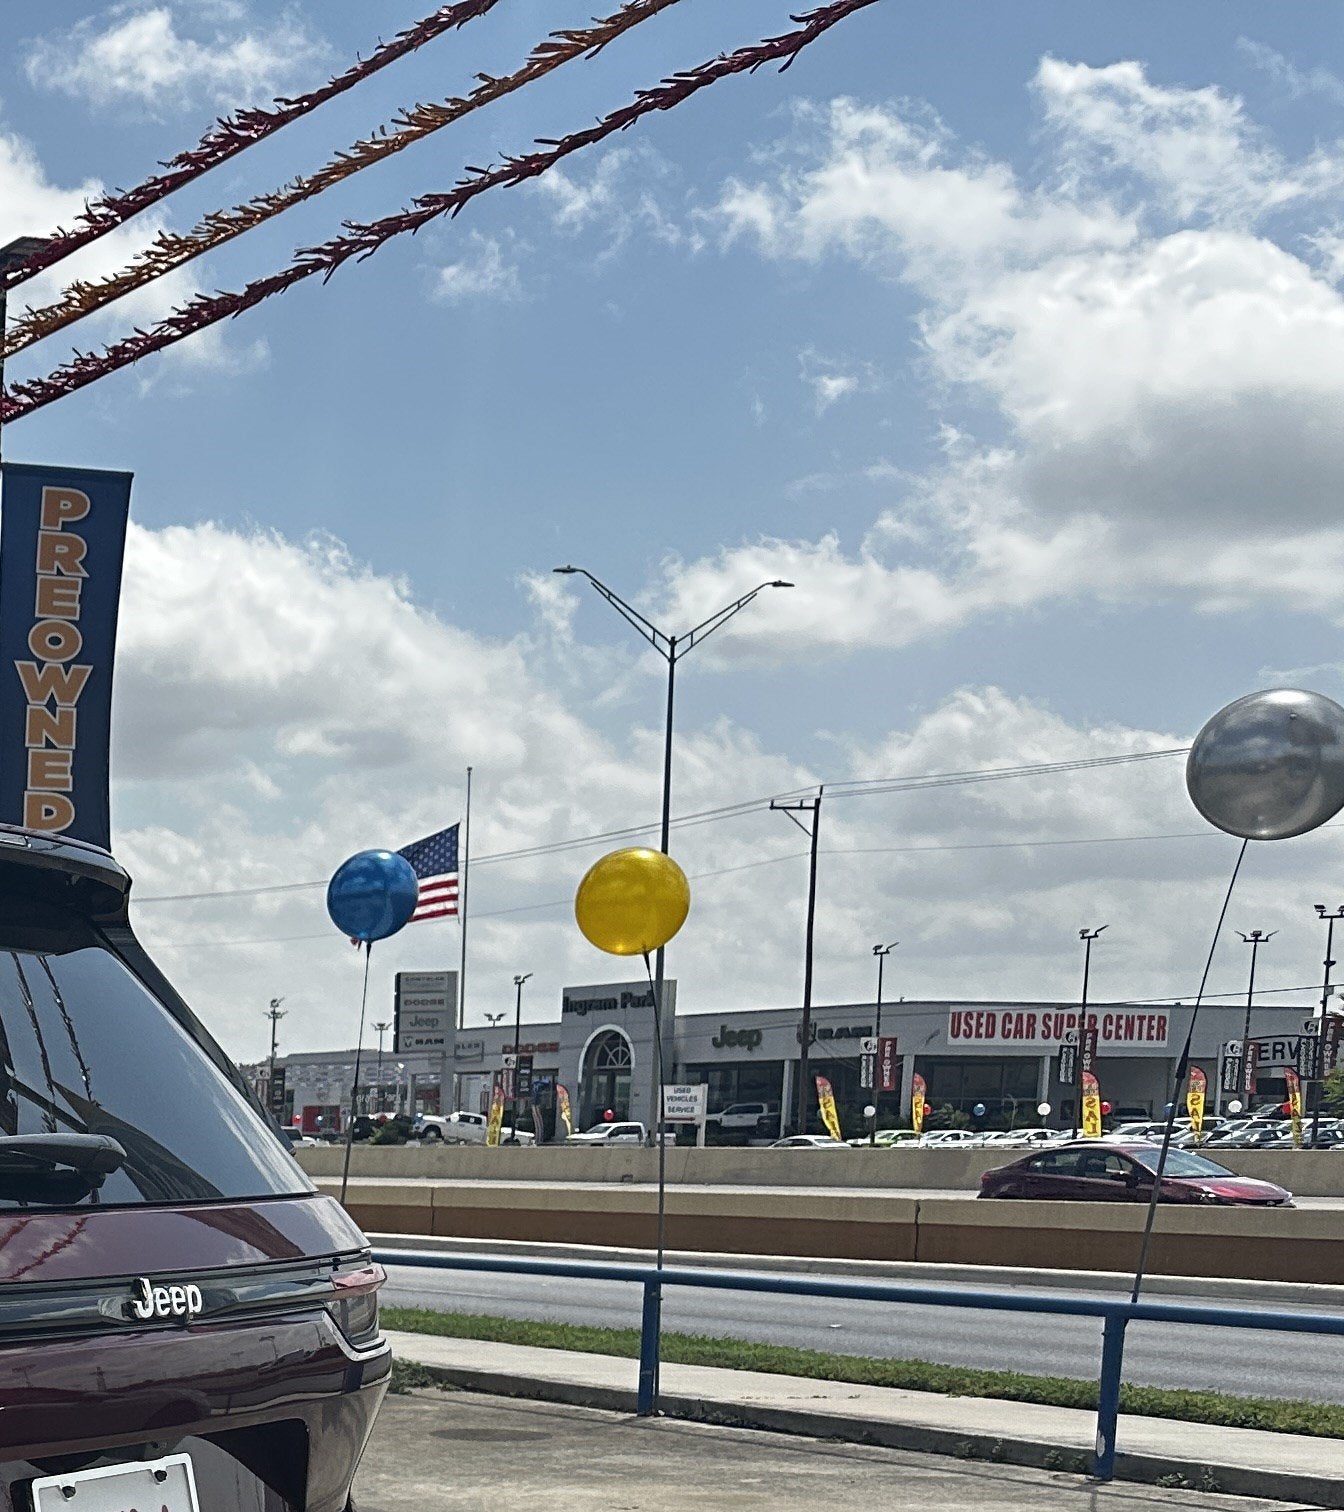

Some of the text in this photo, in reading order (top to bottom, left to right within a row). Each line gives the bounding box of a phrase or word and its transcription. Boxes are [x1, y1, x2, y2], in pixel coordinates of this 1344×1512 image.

[711, 1024, 762, 1052] Jeep
[950, 1011, 997, 1040] USED
[1001, 1012, 1037, 1040] CAR
[1102, 1014, 1168, 1042] CENTER
[132, 1277, 203, 1322] Jeep
